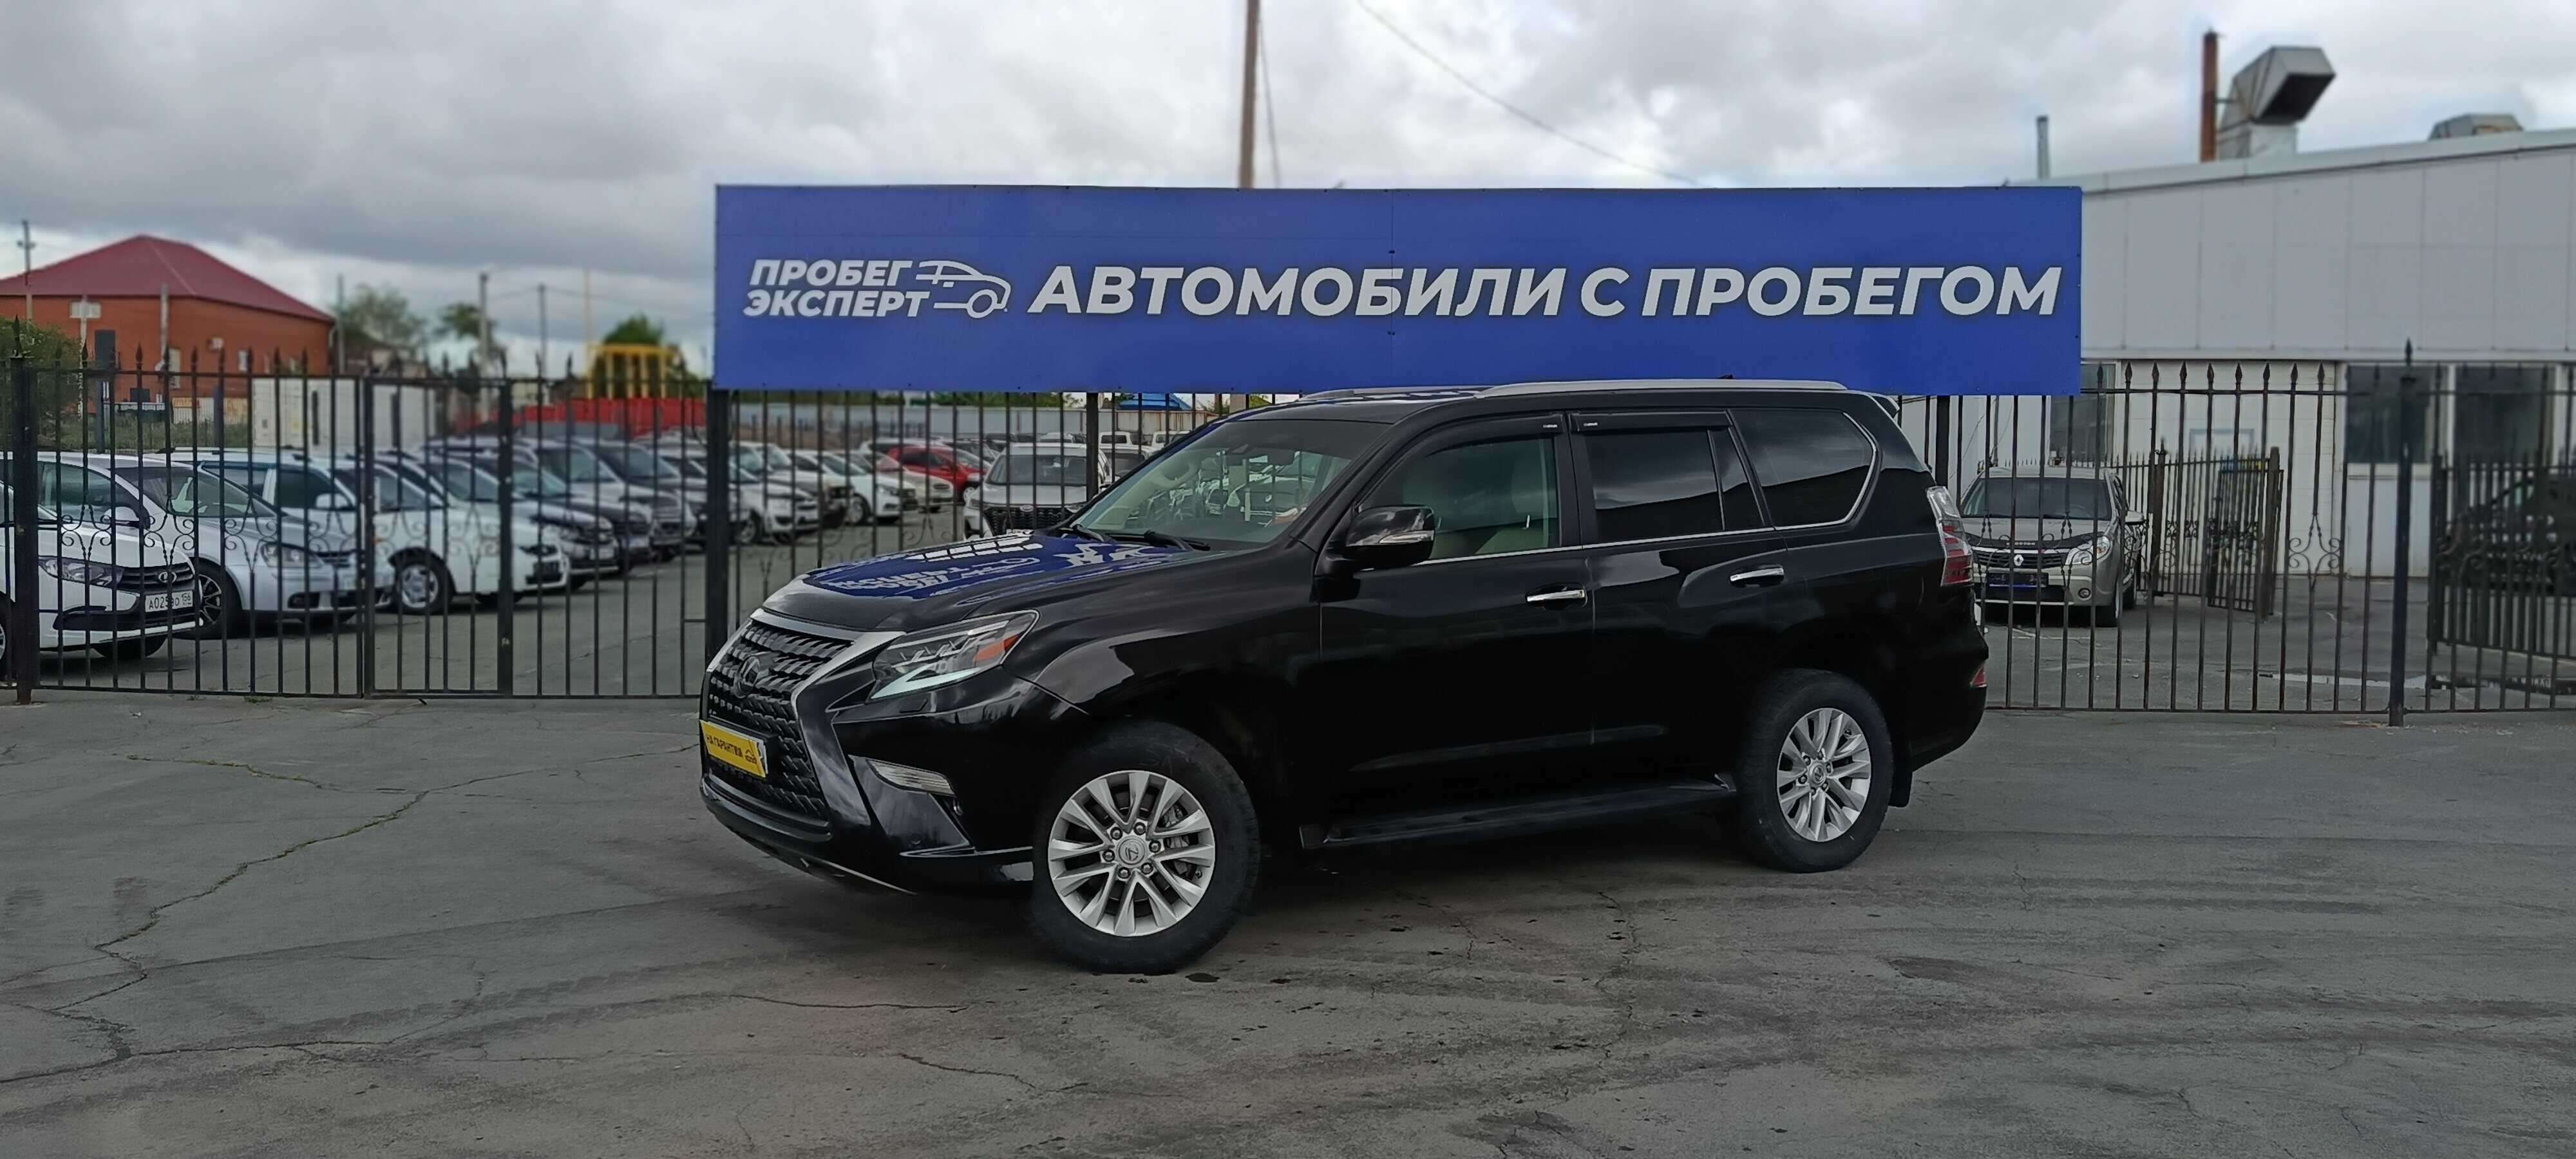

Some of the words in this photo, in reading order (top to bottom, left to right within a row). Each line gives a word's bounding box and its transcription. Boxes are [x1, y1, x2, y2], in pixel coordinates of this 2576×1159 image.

[749, 259, 913, 287] ПРОБЕГ
[743, 289, 931, 317] ЭКСПЕРТ
[1027, 266, 1567, 316] АВТОМОБИЛИ
[1581, 267, 1629, 317] С
[1641, 266, 2062, 316] ПРОБЕГОМ
